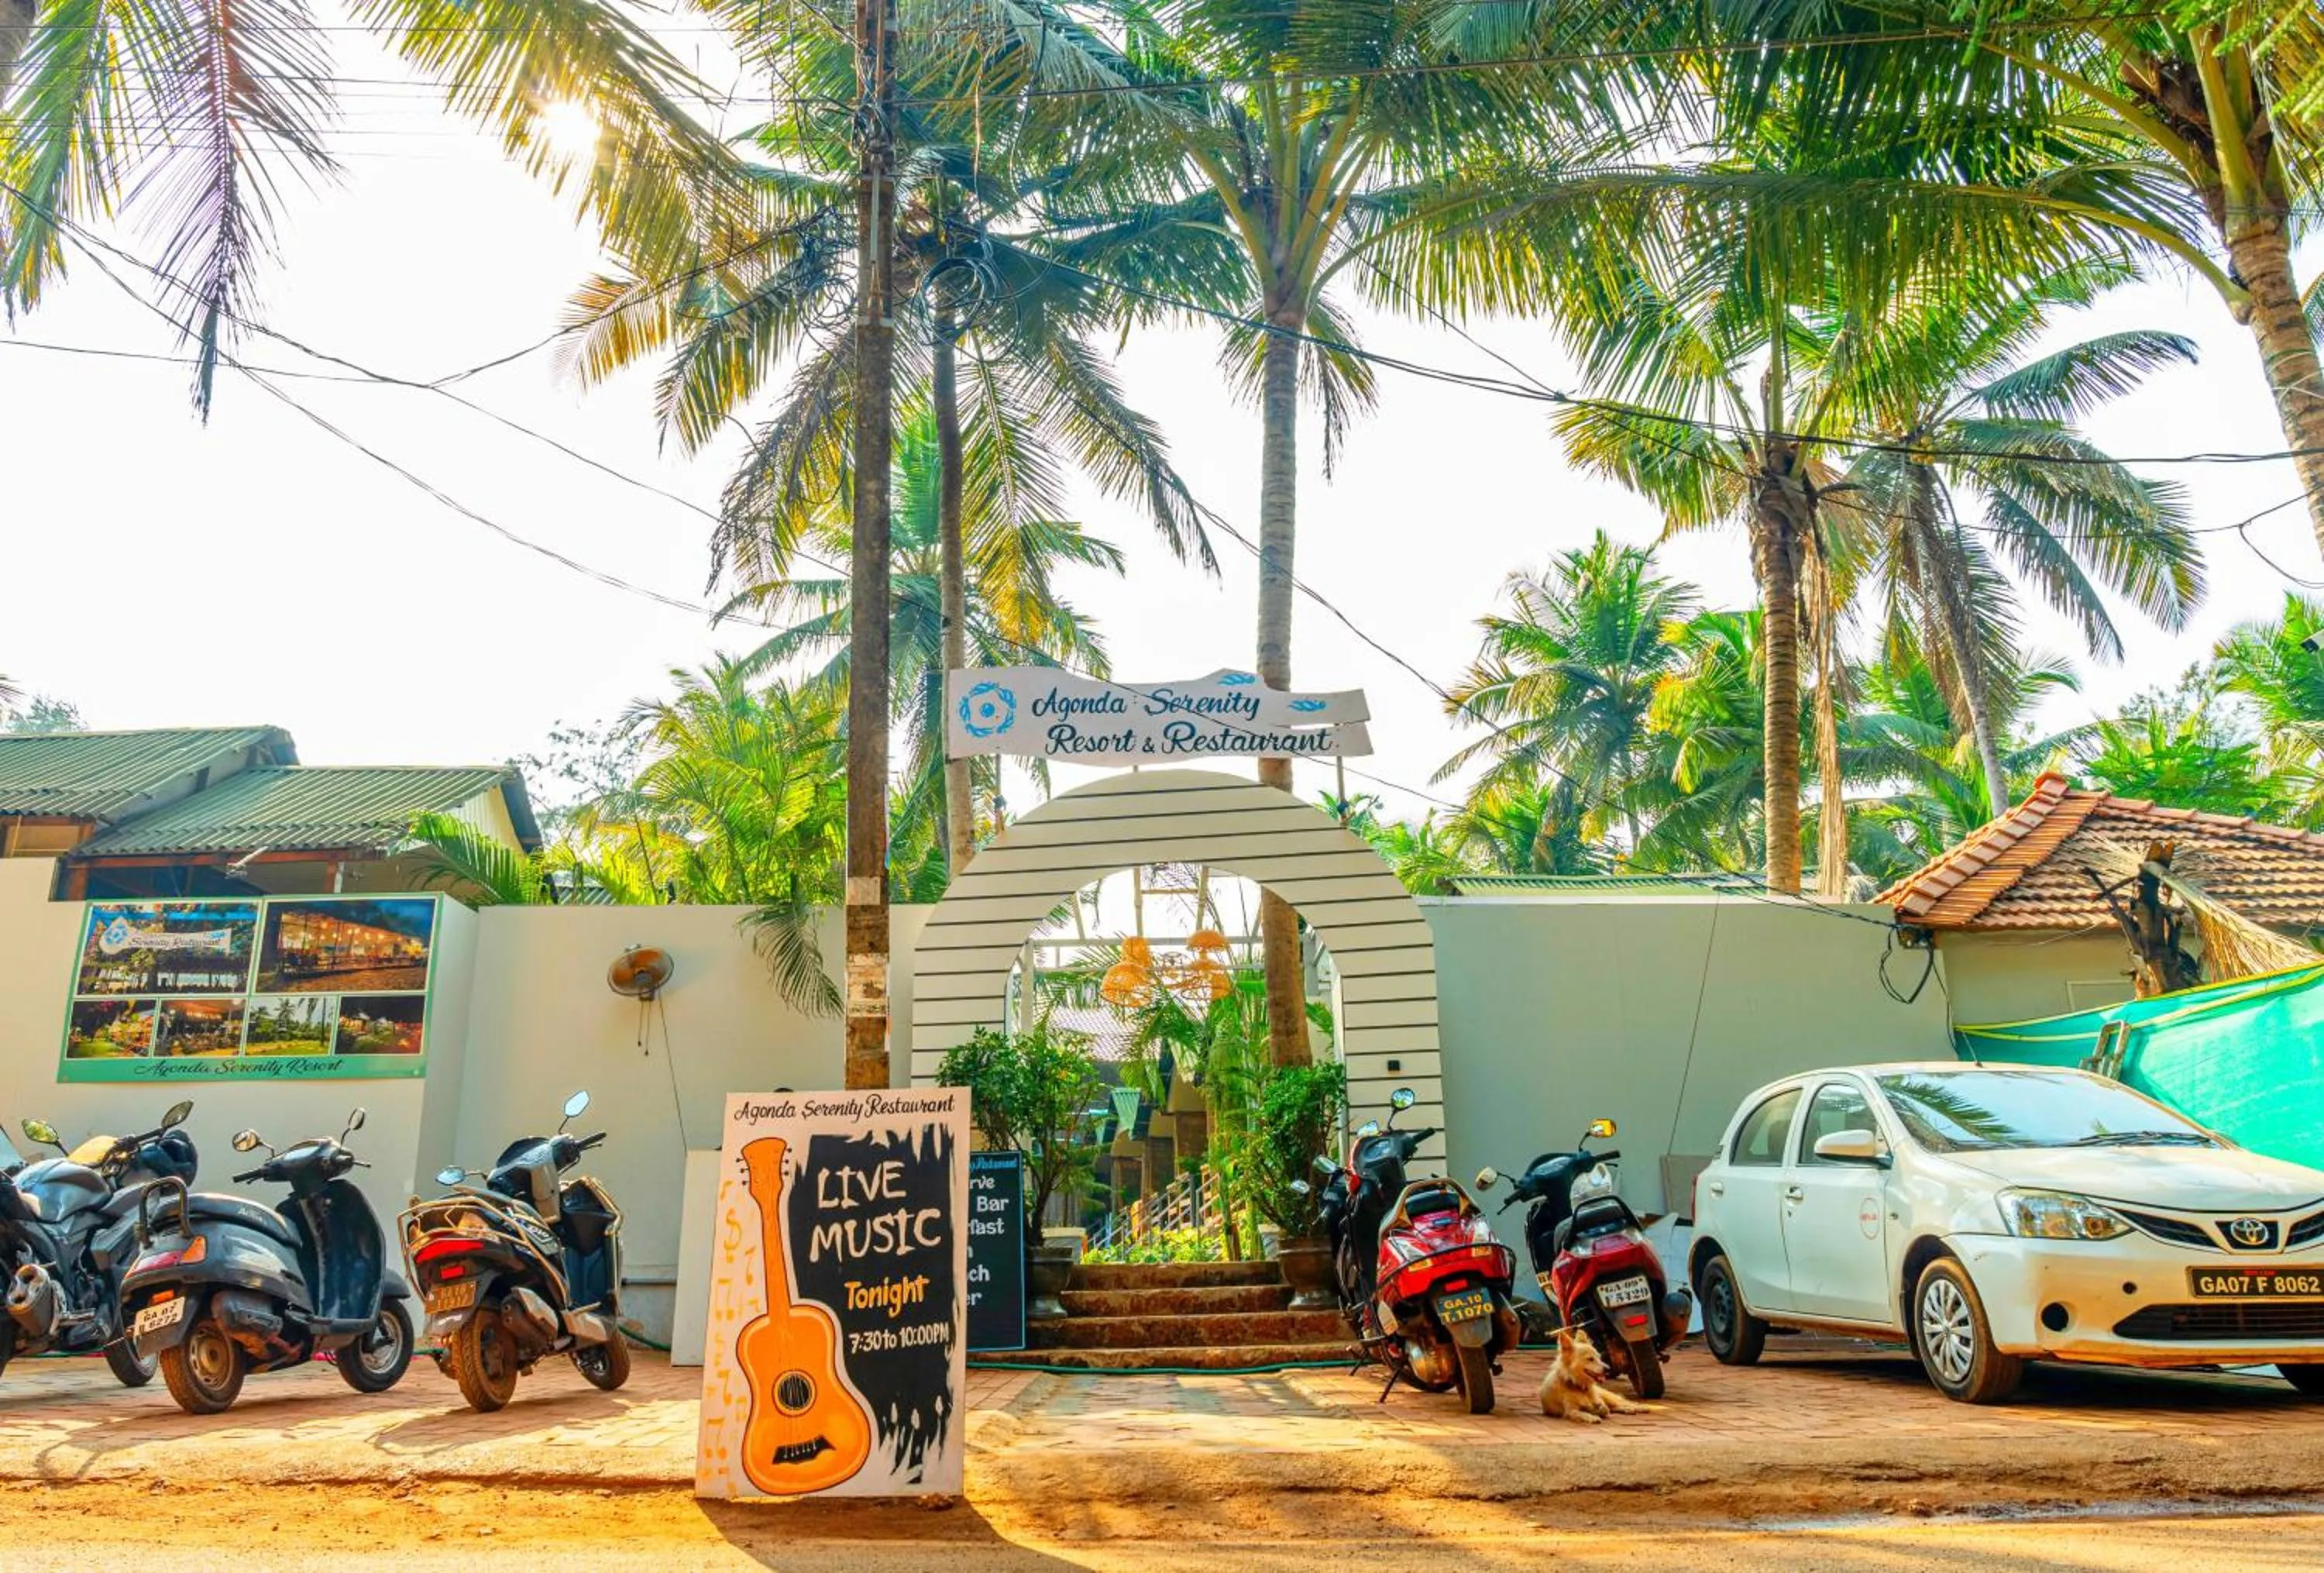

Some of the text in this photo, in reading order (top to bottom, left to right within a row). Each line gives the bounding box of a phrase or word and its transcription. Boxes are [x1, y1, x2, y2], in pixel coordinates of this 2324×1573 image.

[1032, 686, 1260, 722] Agonda Serenity
[1046, 720, 1334, 755] Resort & Restaurant
[133, 1058, 342, 1078] Agonda Serenity Resort
[734, 1093, 956, 1126] Agonda Serenity Restaurant
[817, 1160, 907, 1210] LIVE
[977, 1196, 1009, 1212] Bar
[809, 1207, 942, 1263] MUSIC
[968, 1217, 1005, 1235] fast
[968, 1263, 991, 1282] ch
[2199, 1275, 2321, 1293] GA07 F 8062
[844, 1274, 930, 1317] Tonight
[849, 1330, 882, 1354] 7:30
[883, 1329, 898, 1351] to
